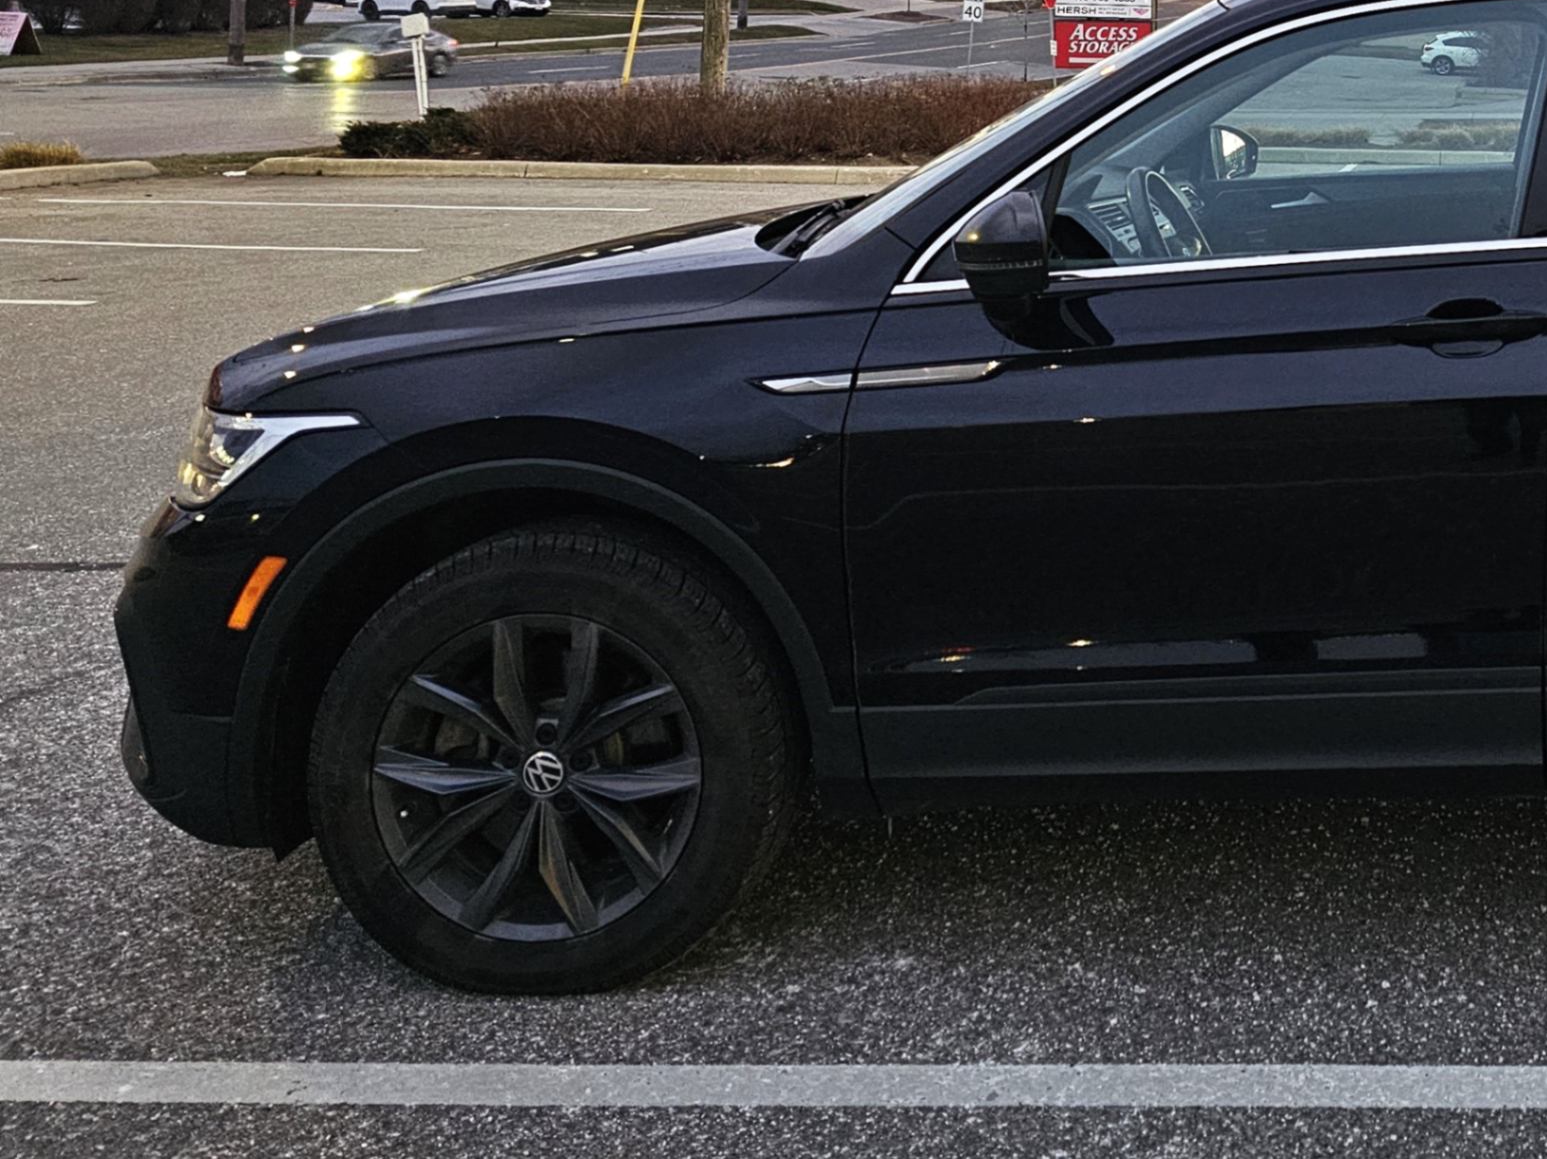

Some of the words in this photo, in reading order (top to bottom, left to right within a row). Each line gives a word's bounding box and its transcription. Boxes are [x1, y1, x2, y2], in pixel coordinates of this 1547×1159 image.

[964, 6, 982, 19] 40
[1057, 6, 1097, 15] HERSH
[1069, 23, 1138, 41] ACCESS
[1068, 40, 1135, 54] STORAG
